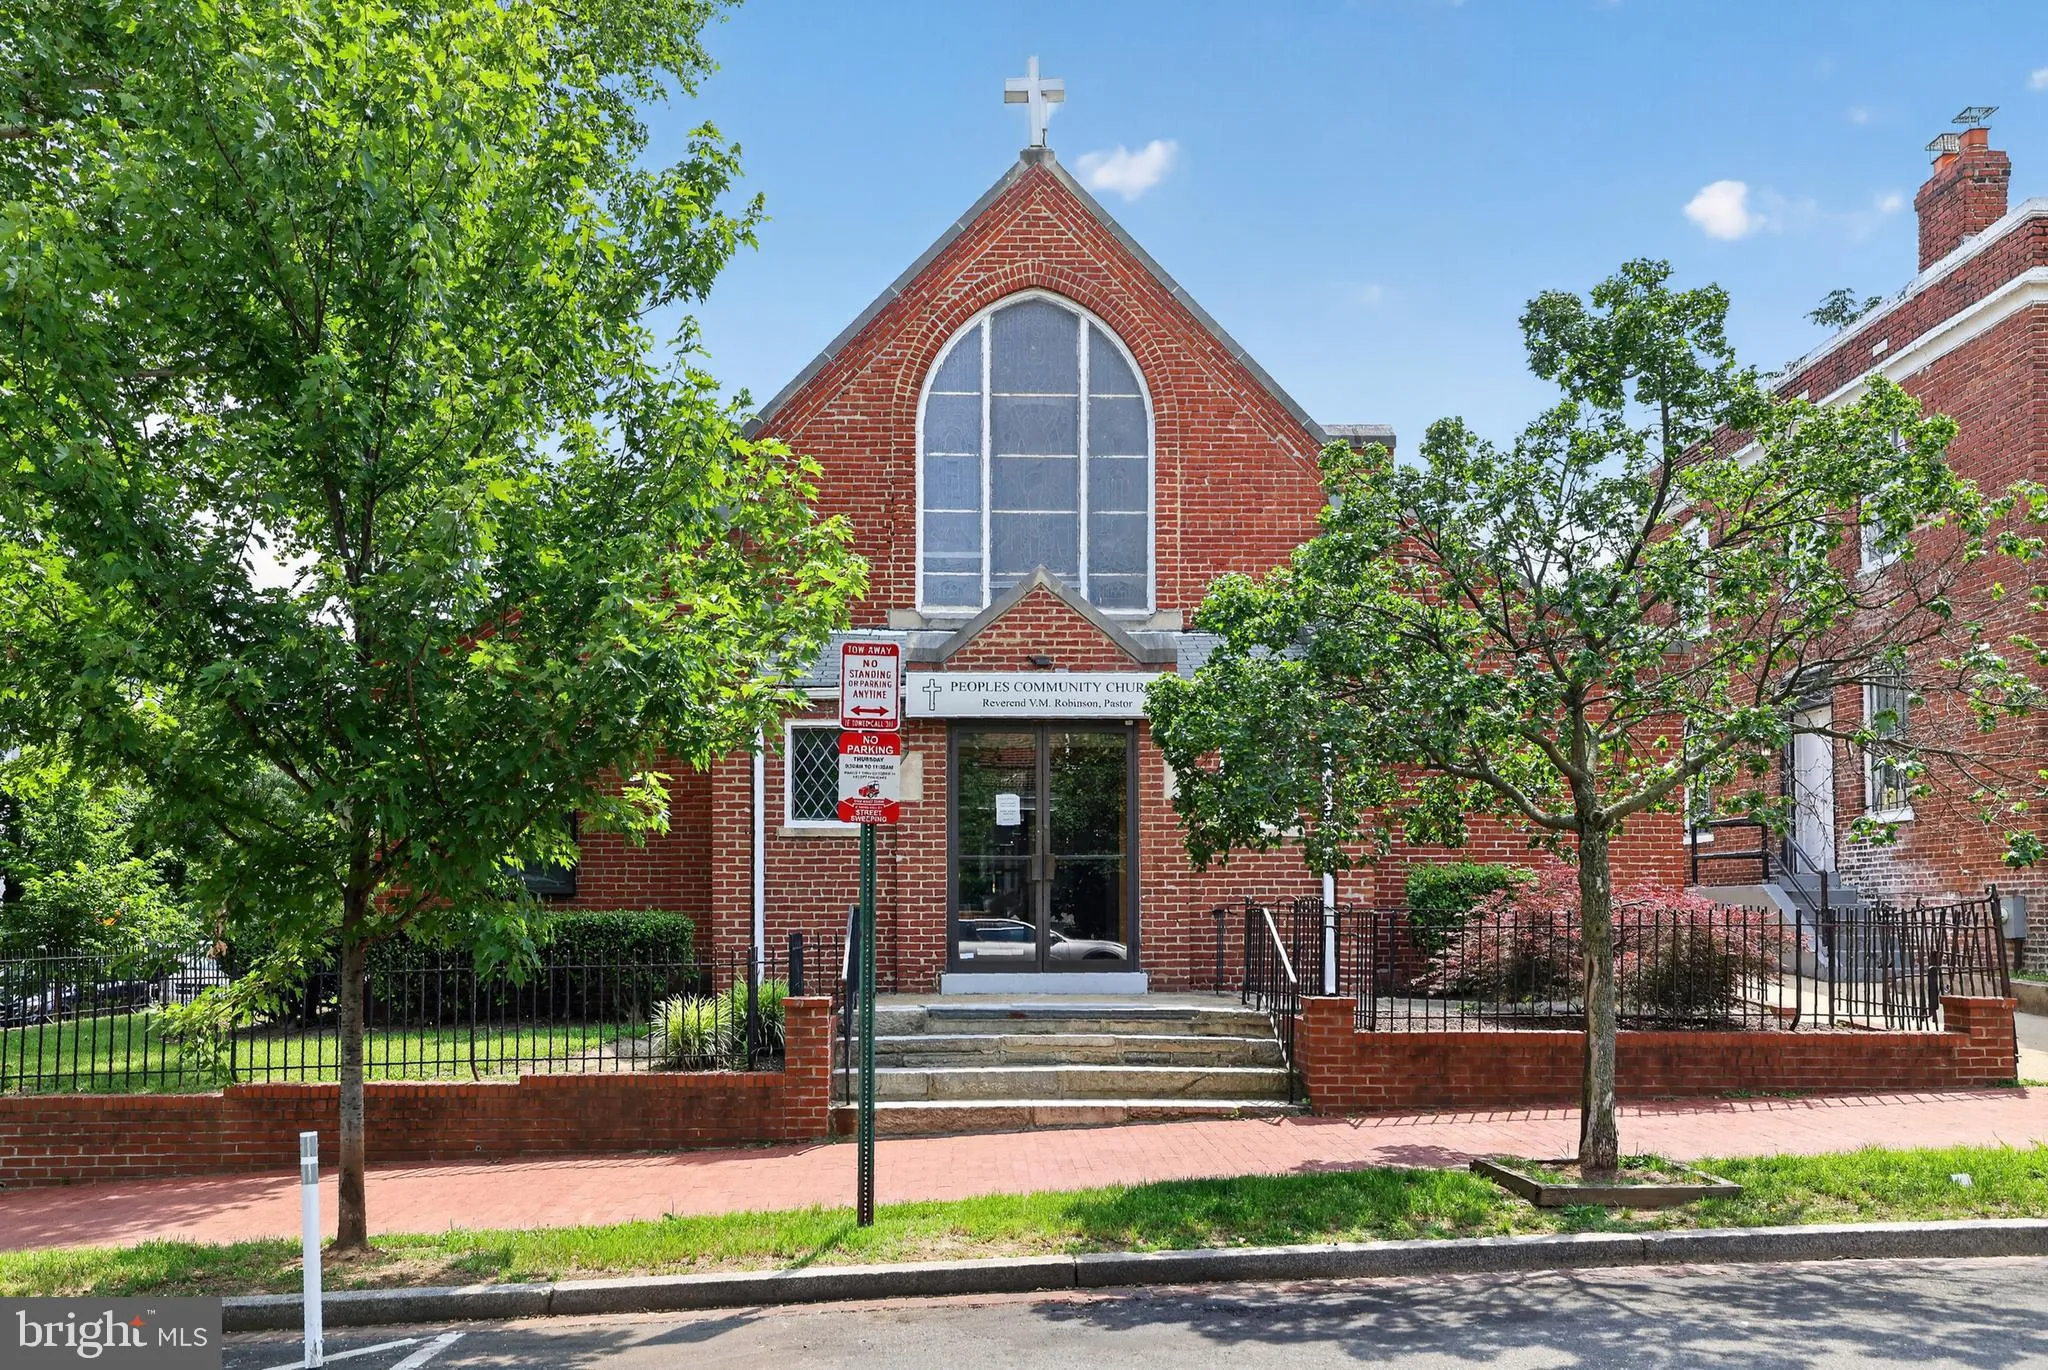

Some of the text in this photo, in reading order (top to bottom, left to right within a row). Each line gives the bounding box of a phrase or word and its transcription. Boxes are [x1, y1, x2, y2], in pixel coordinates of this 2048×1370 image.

[848, 645, 891, 655] TOW AWAY
[862, 659, 878, 668] NO
[850, 669, 891, 679] STANDING
[848, 680, 892, 689] OR PARKING
[950, 681, 1146, 694] PEOPLES COMMUNITY CHUR
[853, 690, 887, 699] ANYTIME
[982, 698, 1134, 709] Reverend V.M. Robinson, Pastor
[863, 735, 879, 744] NO
[847, 745, 894, 754] PARKING
[850, 815, 887, 823] SWEEPING
